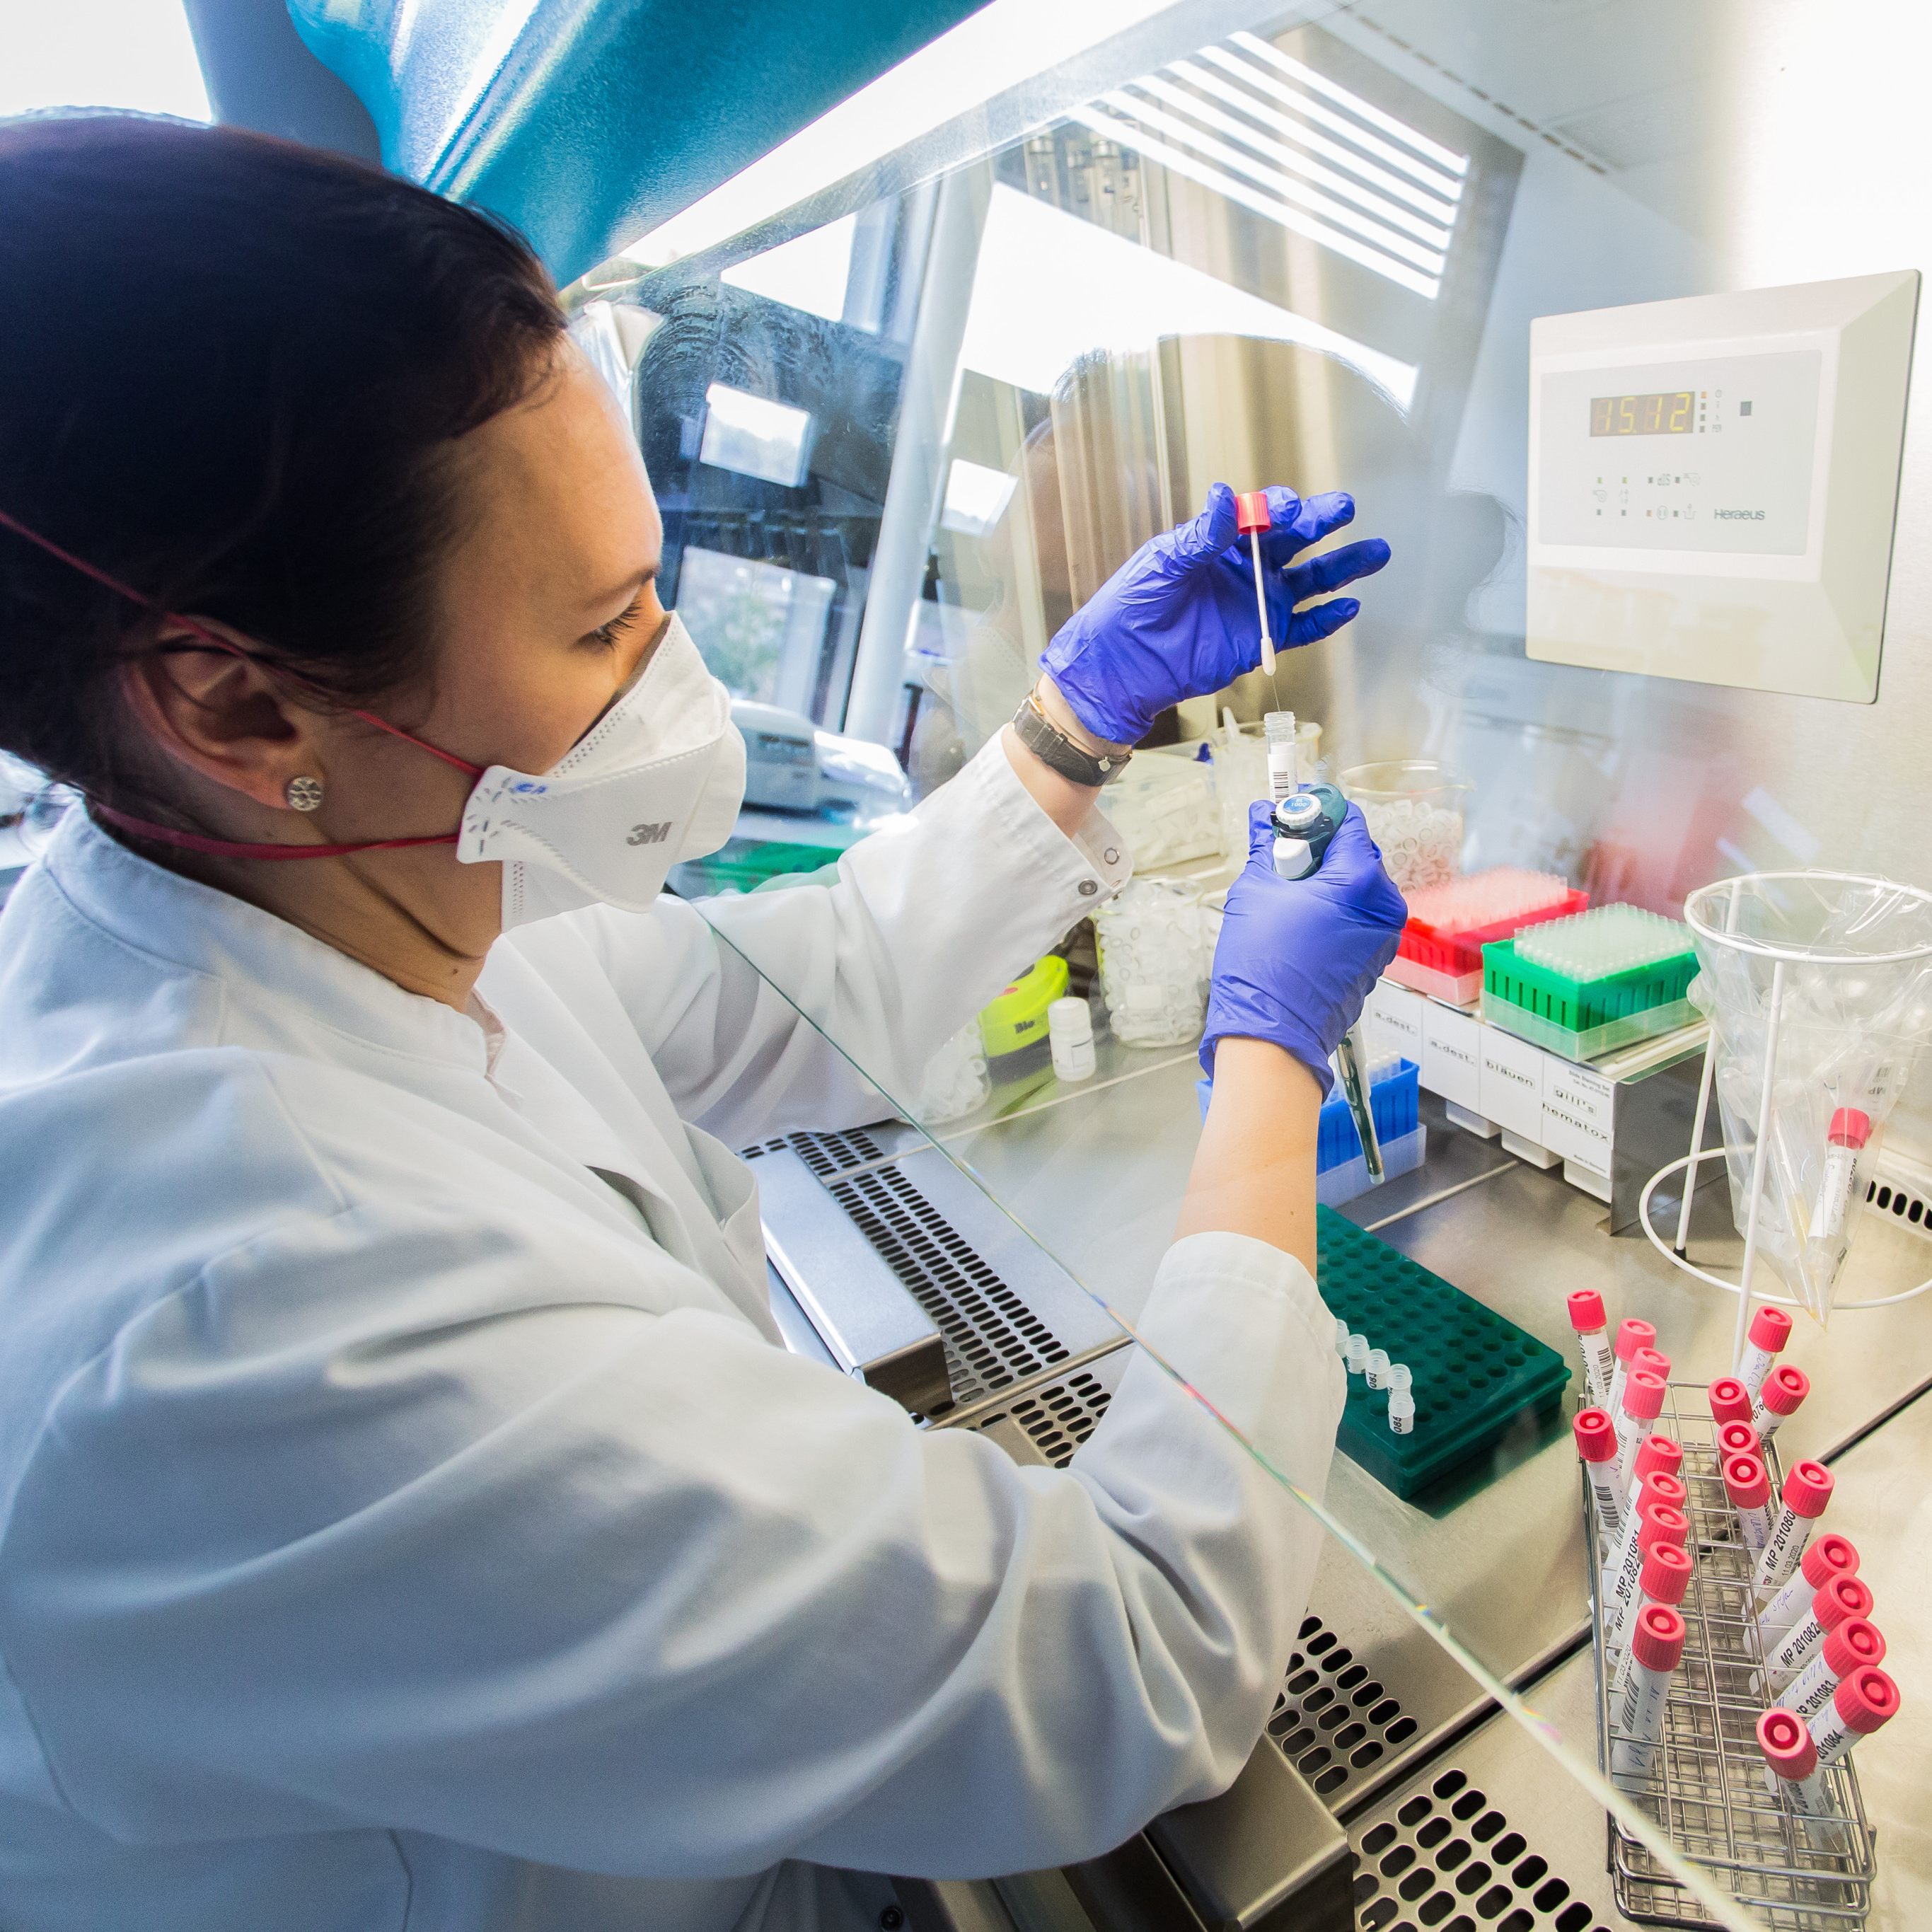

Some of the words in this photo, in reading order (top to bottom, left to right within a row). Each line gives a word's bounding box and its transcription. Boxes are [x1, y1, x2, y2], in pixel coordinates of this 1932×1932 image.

[1714, 508, 1766, 521] Heraeus
[625, 821, 673, 846] 3M
[1486, 1060, 1534, 1087] bläuen
[1541, 1102, 1609, 1142] hematox
[1765, 1549, 1778, 1571] MP
[1774, 1510, 1796, 1552] 201080
[1616, 1575, 1626, 1598] MP
[1615, 1607, 1625, 1631] MP
[1780, 1648, 1795, 1667] MP
[1792, 1621, 1821, 1655] 201082
[1805, 1679, 1837, 1709] 201083
